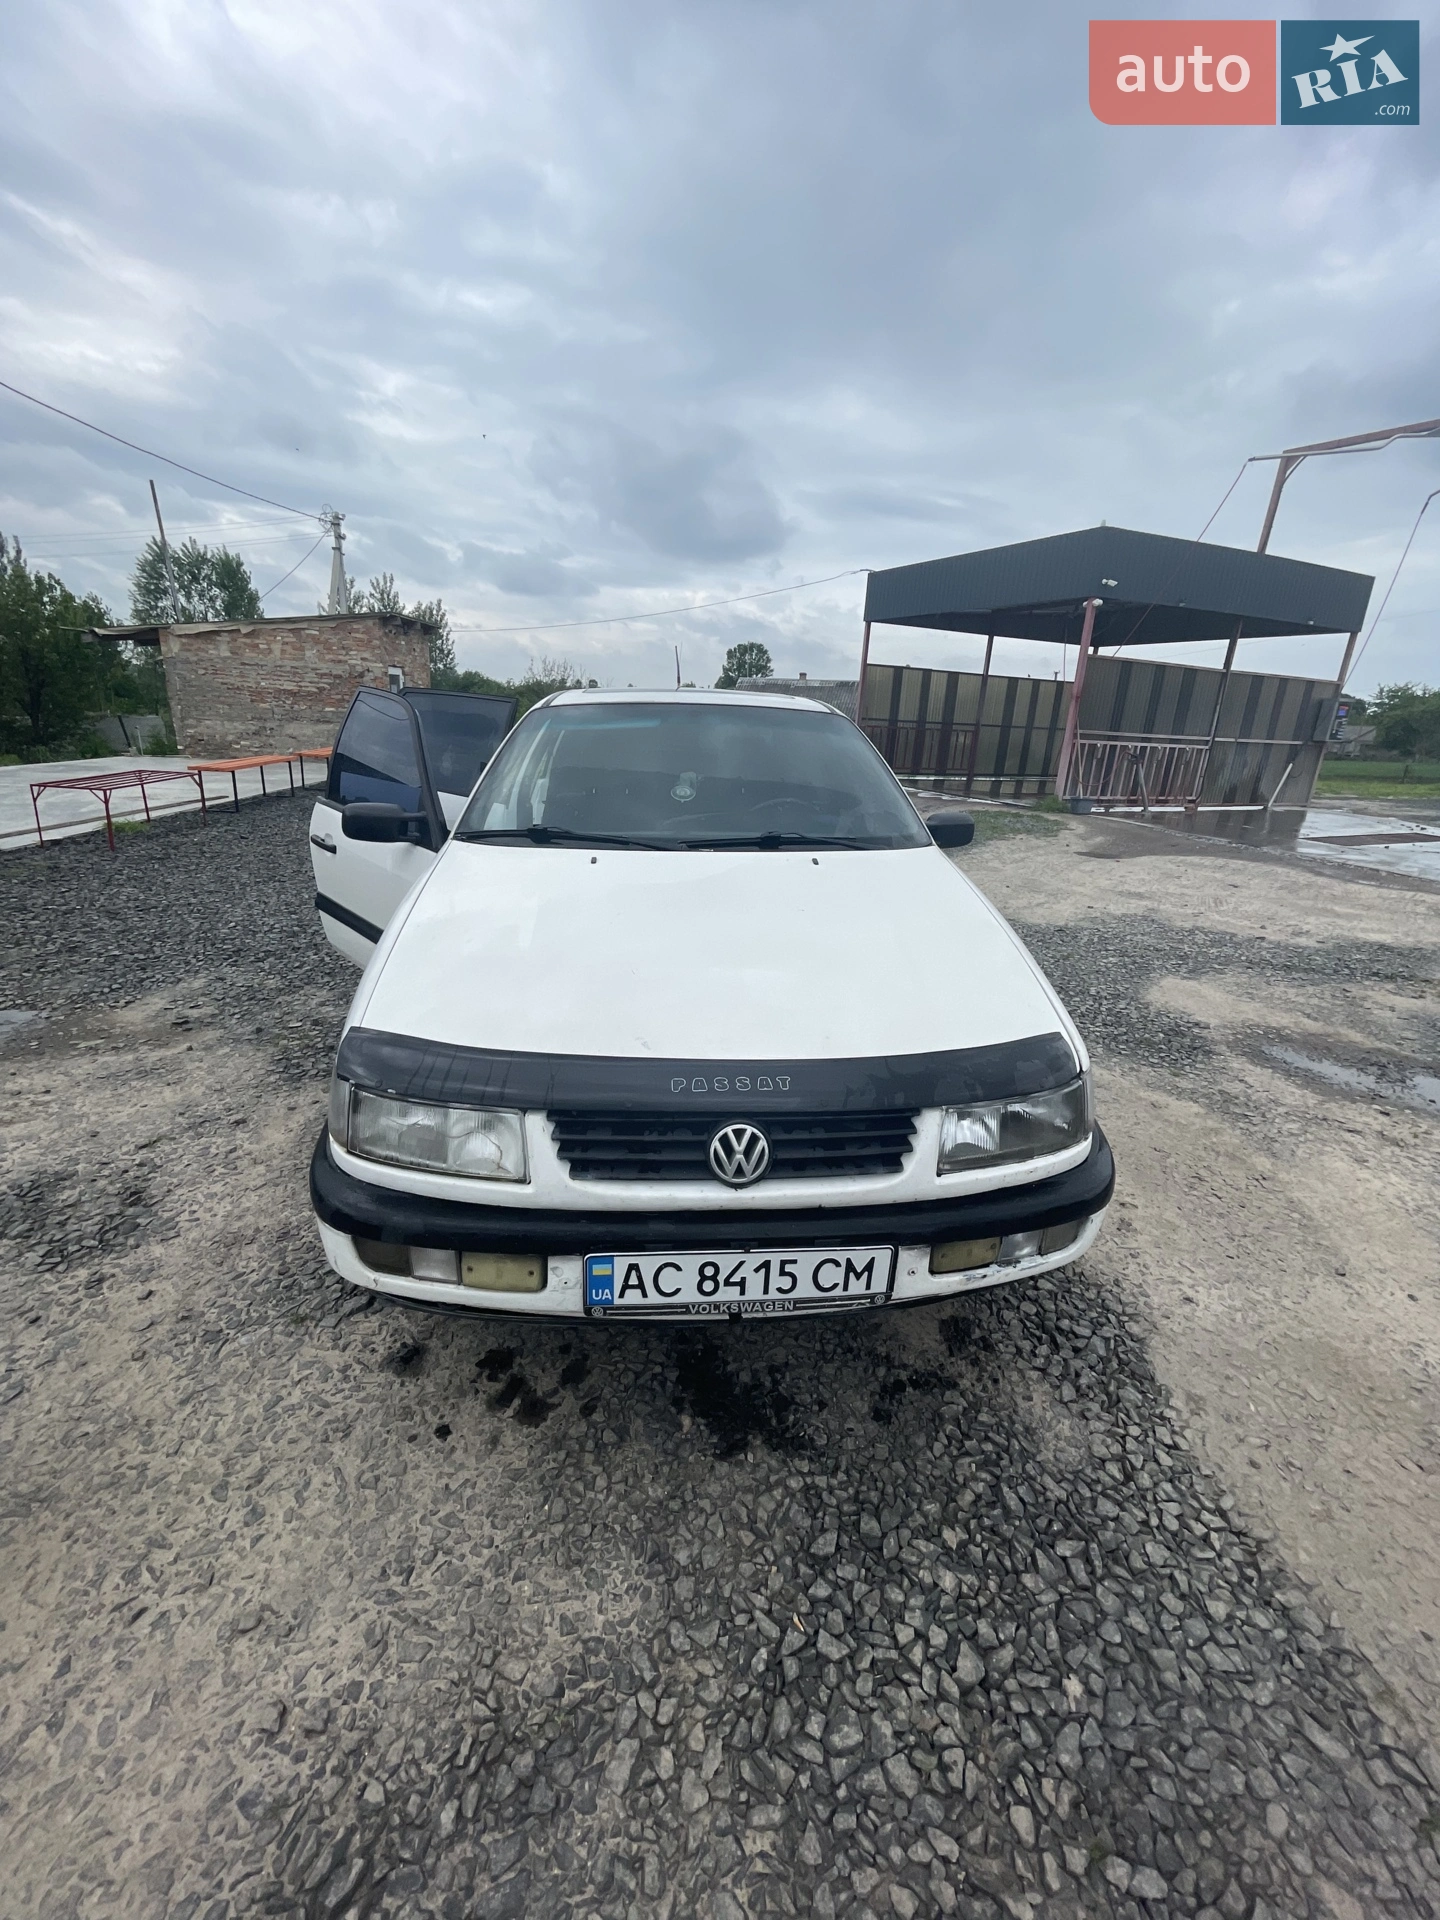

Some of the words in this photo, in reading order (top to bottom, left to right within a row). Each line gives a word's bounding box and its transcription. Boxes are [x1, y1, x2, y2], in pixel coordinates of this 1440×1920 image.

[670, 1076, 791, 1093] PASSAT
[617, 1262, 684, 1299] AC
[696, 1259, 799, 1298] 8415
[811, 1256, 876, 1293] CM
[592, 1288, 612, 1300] UA
[688, 1300, 794, 1314] VOLKSWAGEN
